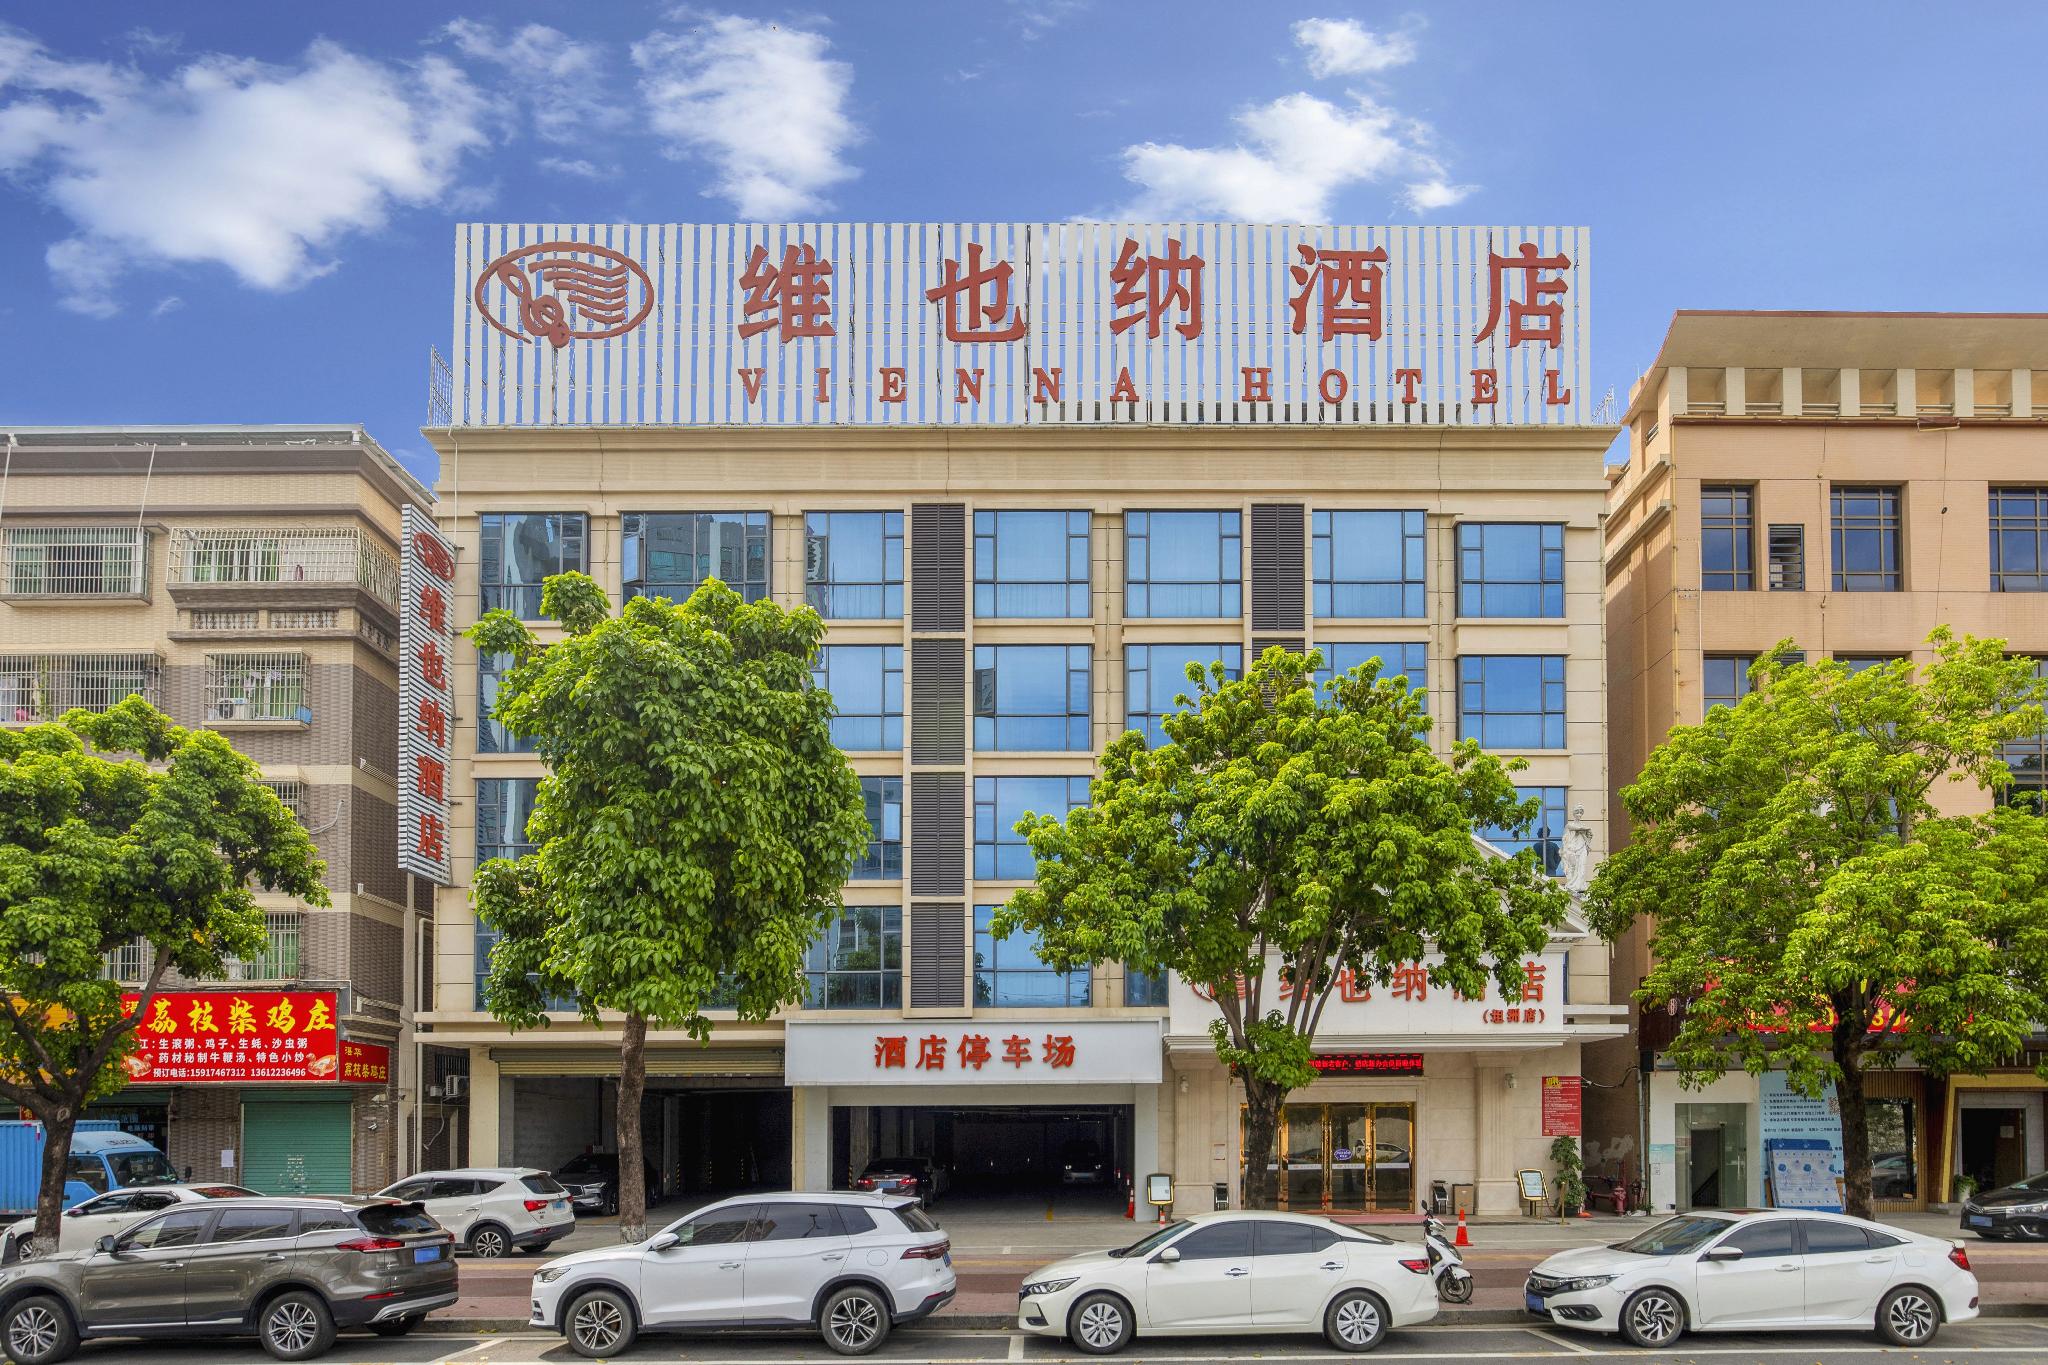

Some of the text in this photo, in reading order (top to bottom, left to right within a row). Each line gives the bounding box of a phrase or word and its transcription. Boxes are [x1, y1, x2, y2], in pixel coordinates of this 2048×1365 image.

[738, 238, 1572, 350] 维也纳酒店
[738, 367, 1571, 404] VIENNA HOTEL
[416, 584, 448, 864] 维也纳酒店
[1278, 961, 1547, 1003] 也纳店
[146, 996, 336, 1034] 荔枝柴鸡庄
[874, 1034, 1077, 1070] 酒店停车场
[250, 1068, 306, 1077] 13612236496
